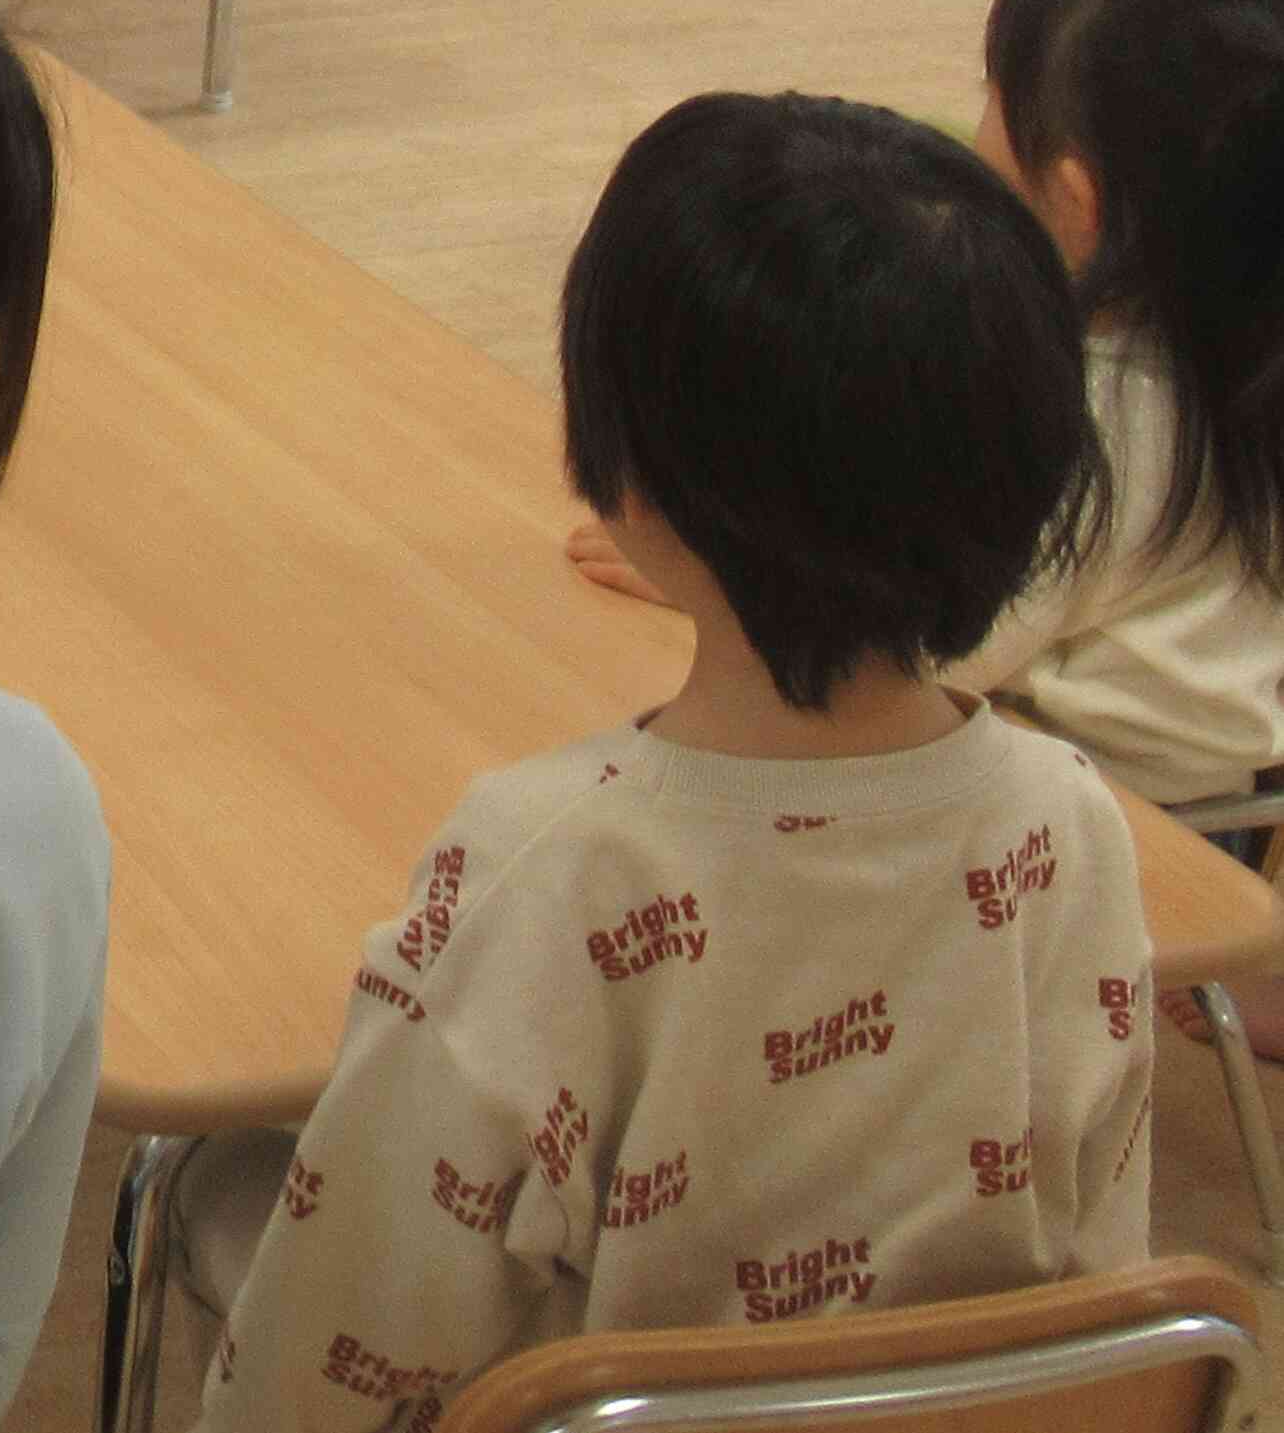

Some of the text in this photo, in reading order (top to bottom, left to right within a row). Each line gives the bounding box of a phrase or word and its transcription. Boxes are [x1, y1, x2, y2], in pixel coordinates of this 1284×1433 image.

[585, 891, 703, 963] Bright
[354, 966, 427, 1023] unny
[764, 989, 889, 1061] Bright
[768, 1022, 896, 1085] Sunny
[734, 1237, 872, 1292] Bright
[743, 1270, 877, 1324] Sunny
